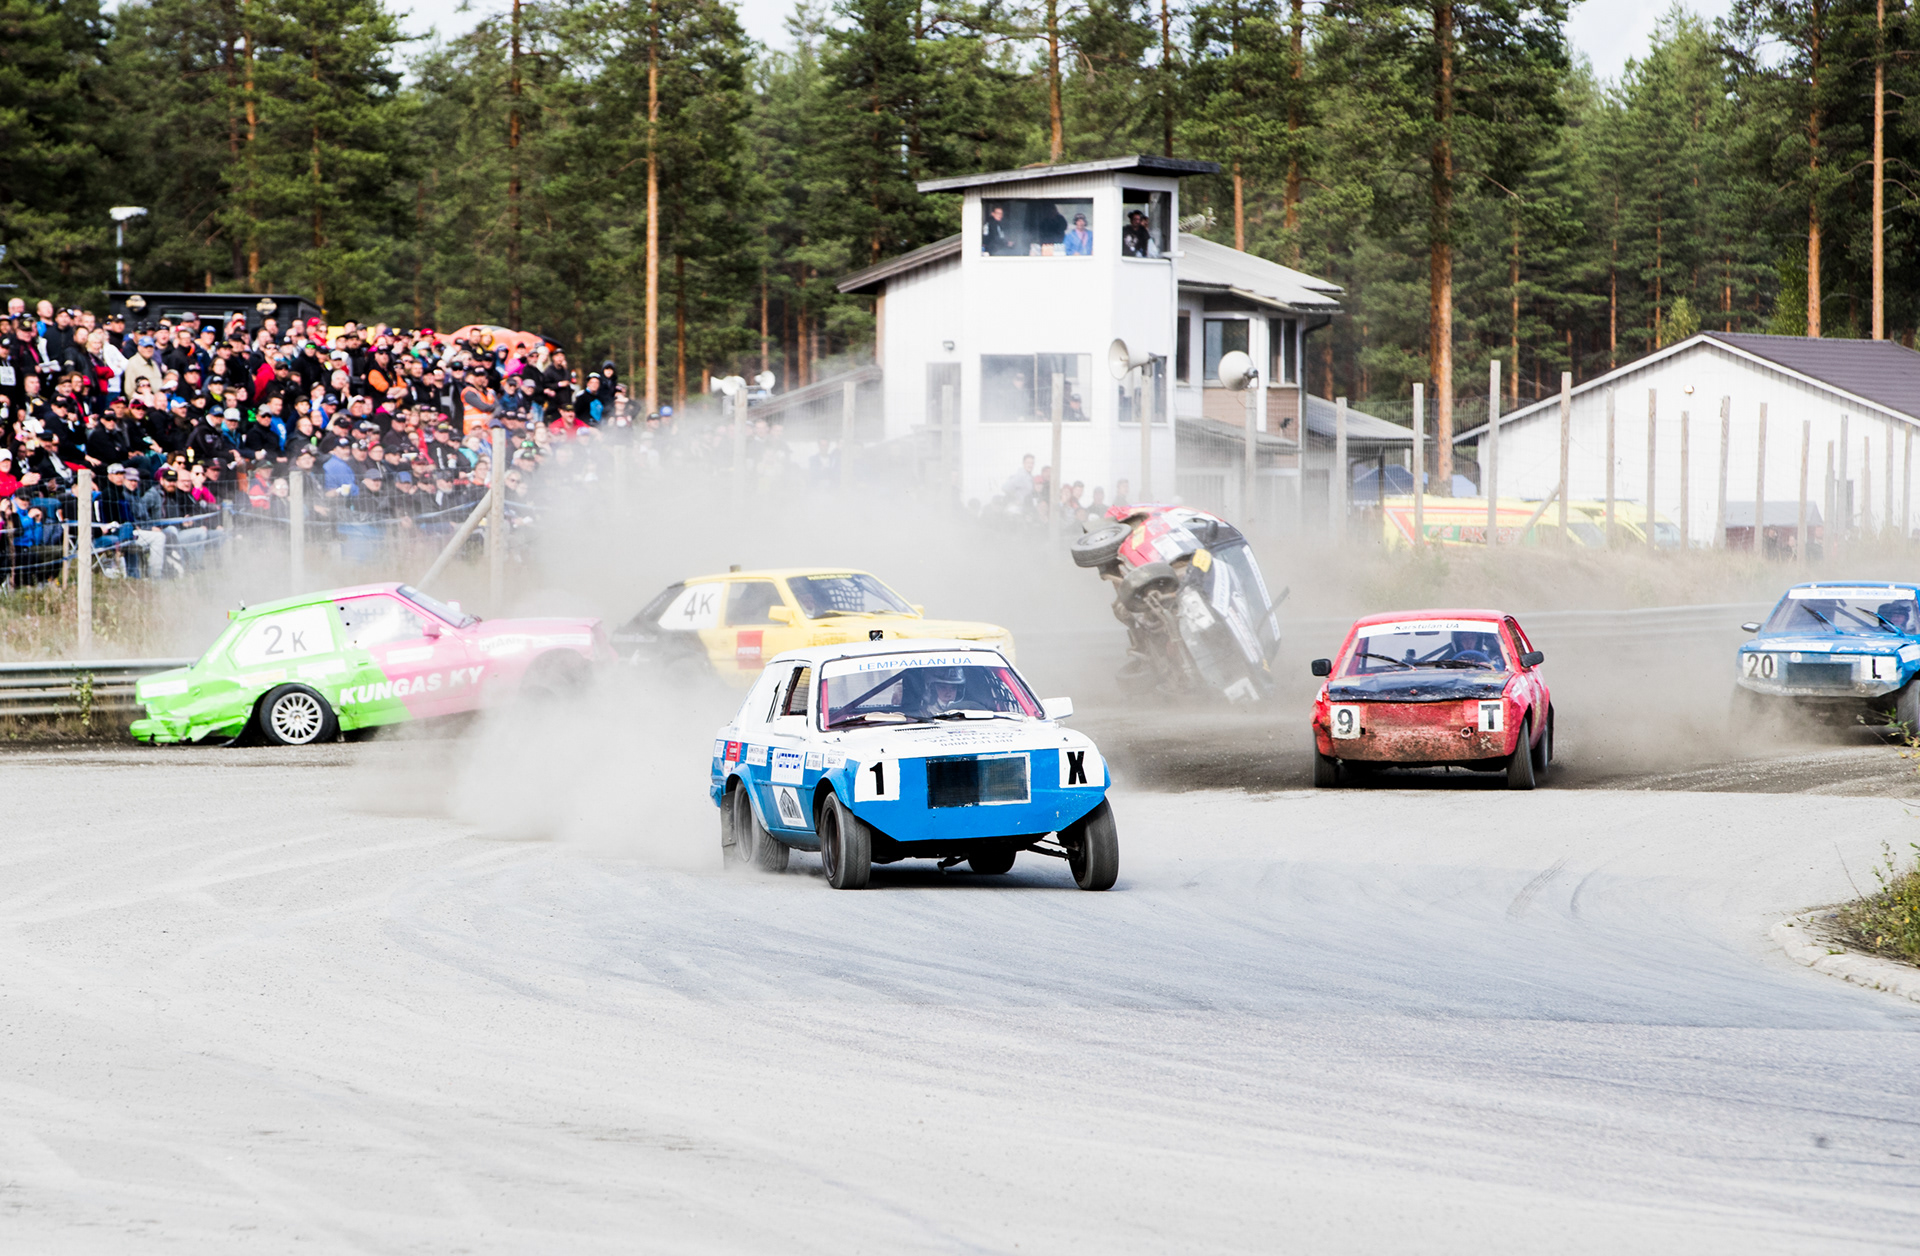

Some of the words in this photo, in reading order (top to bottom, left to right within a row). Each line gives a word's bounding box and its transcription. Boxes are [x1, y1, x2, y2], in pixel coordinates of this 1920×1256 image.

[1394, 622, 1443, 631] Karstulan
[952, 657, 973, 665] UA
[1747, 653, 1774, 679] 20
[1871, 658, 1882, 680] L
[339, 669, 443, 706] KUNGAS
[449, 664, 486, 688] KY
[1337, 708, 1354, 735] 9
[1481, 703, 1501, 730] T
[868, 761, 885, 796] 1
[1066, 750, 1088, 785] X
